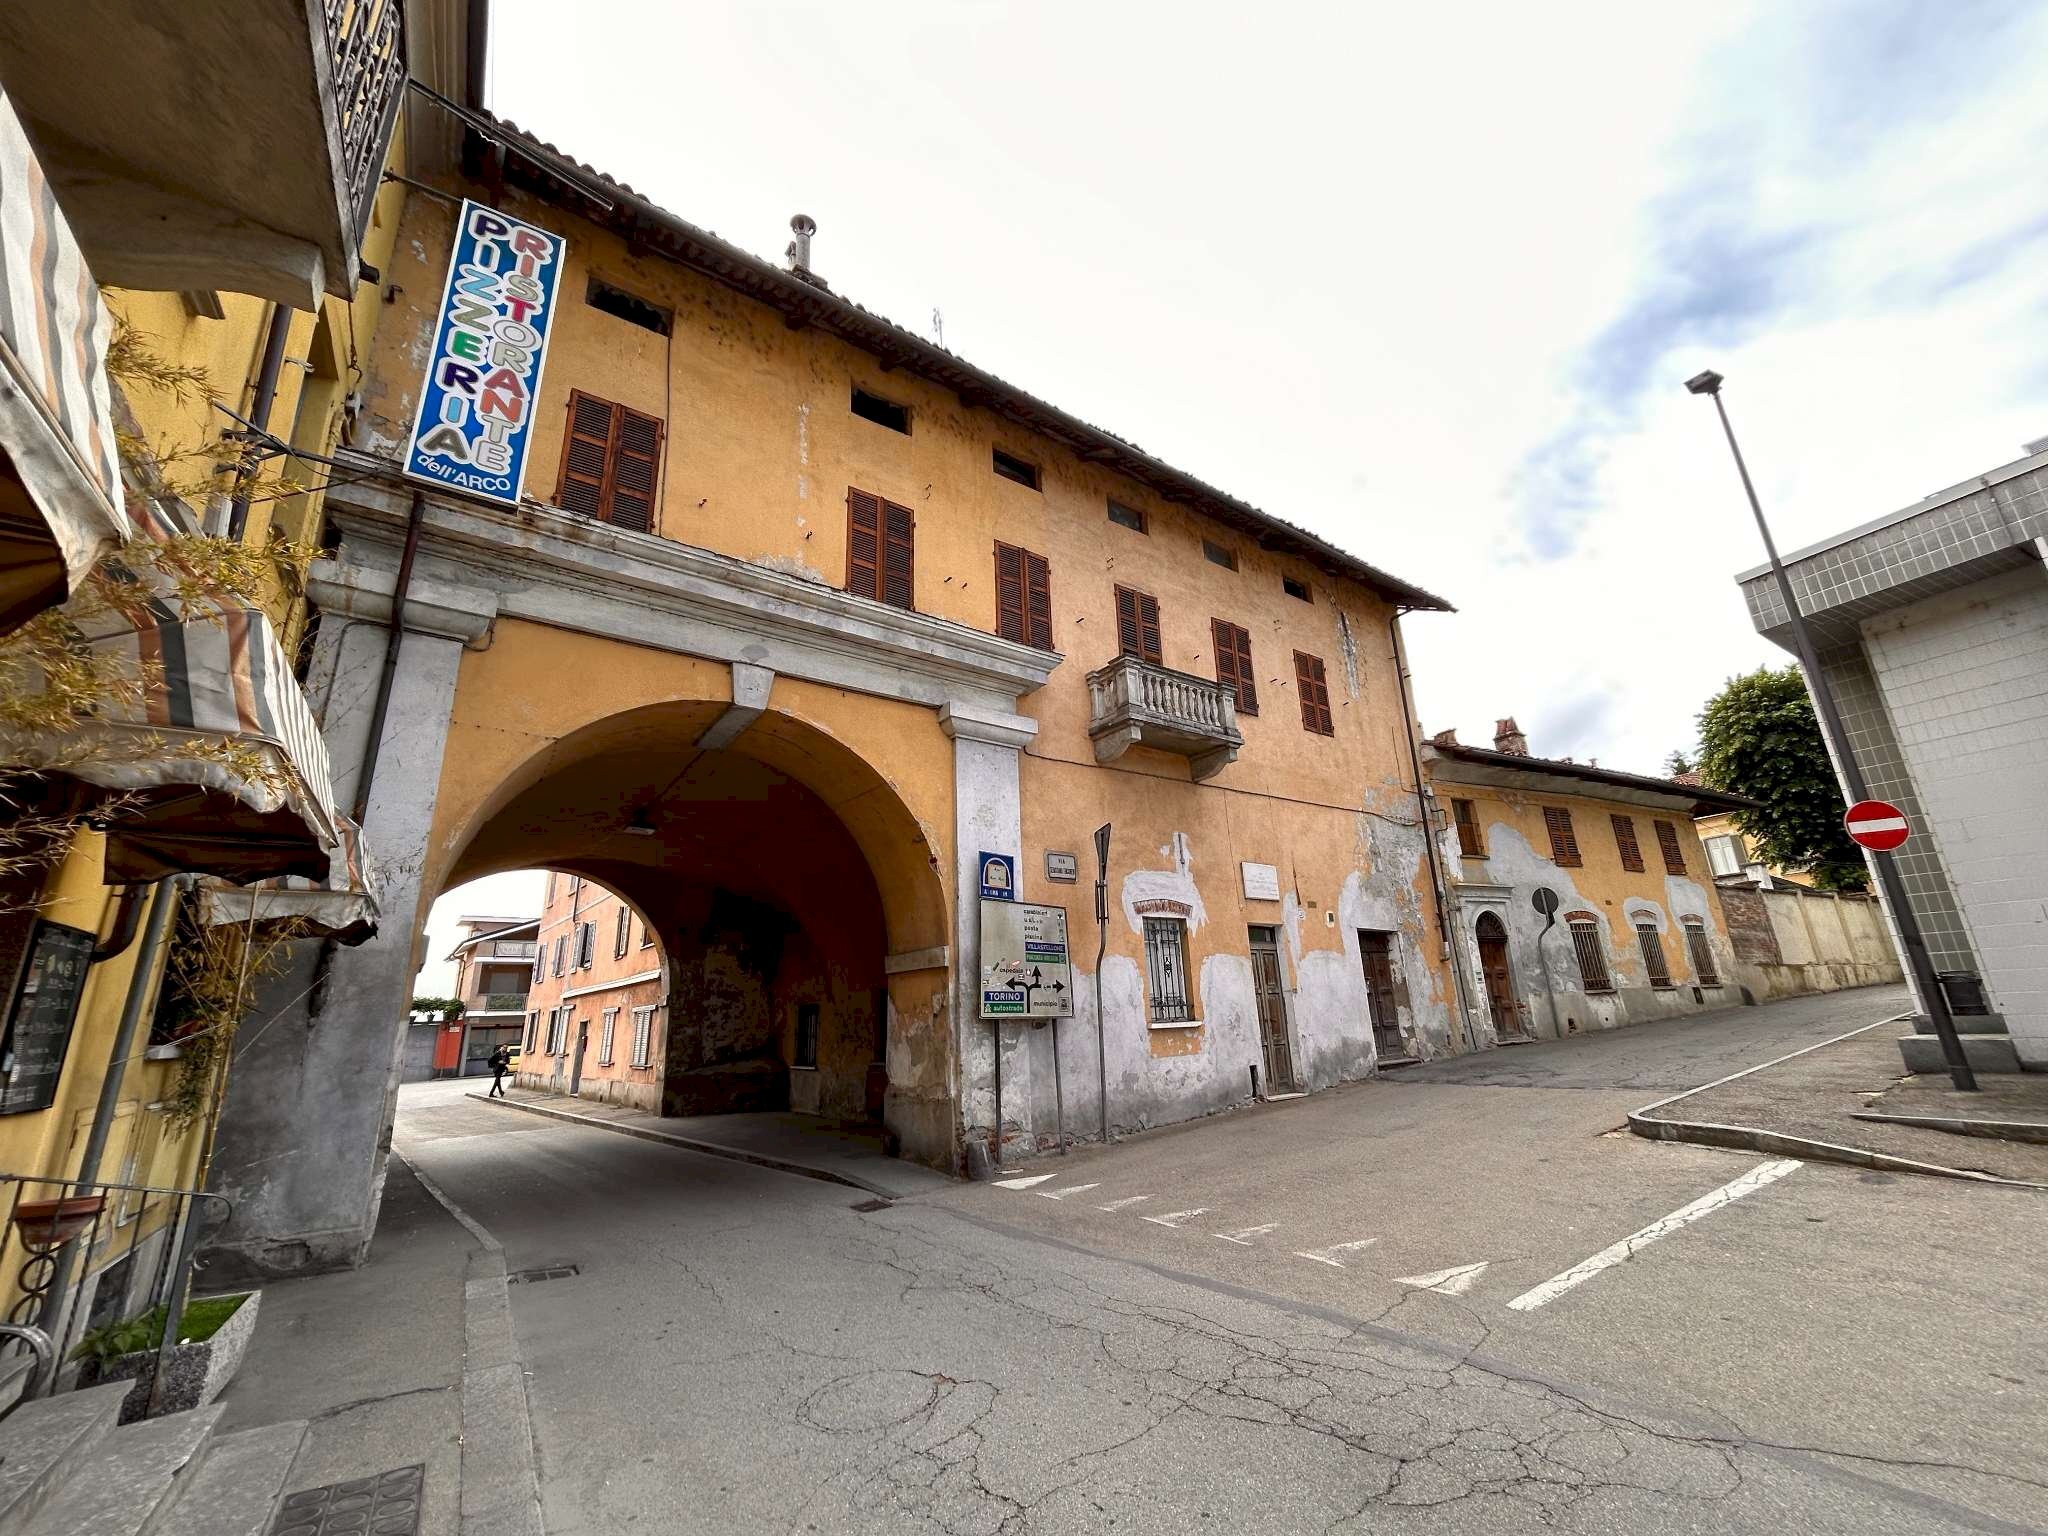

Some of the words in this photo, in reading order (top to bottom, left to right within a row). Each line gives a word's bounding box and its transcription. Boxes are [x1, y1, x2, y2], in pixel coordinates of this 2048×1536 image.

[418, 212, 510, 462] PIZZERIA
[473, 228, 551, 474] RISTORANTE
[989, 992, 1021, 1001] TORINO
